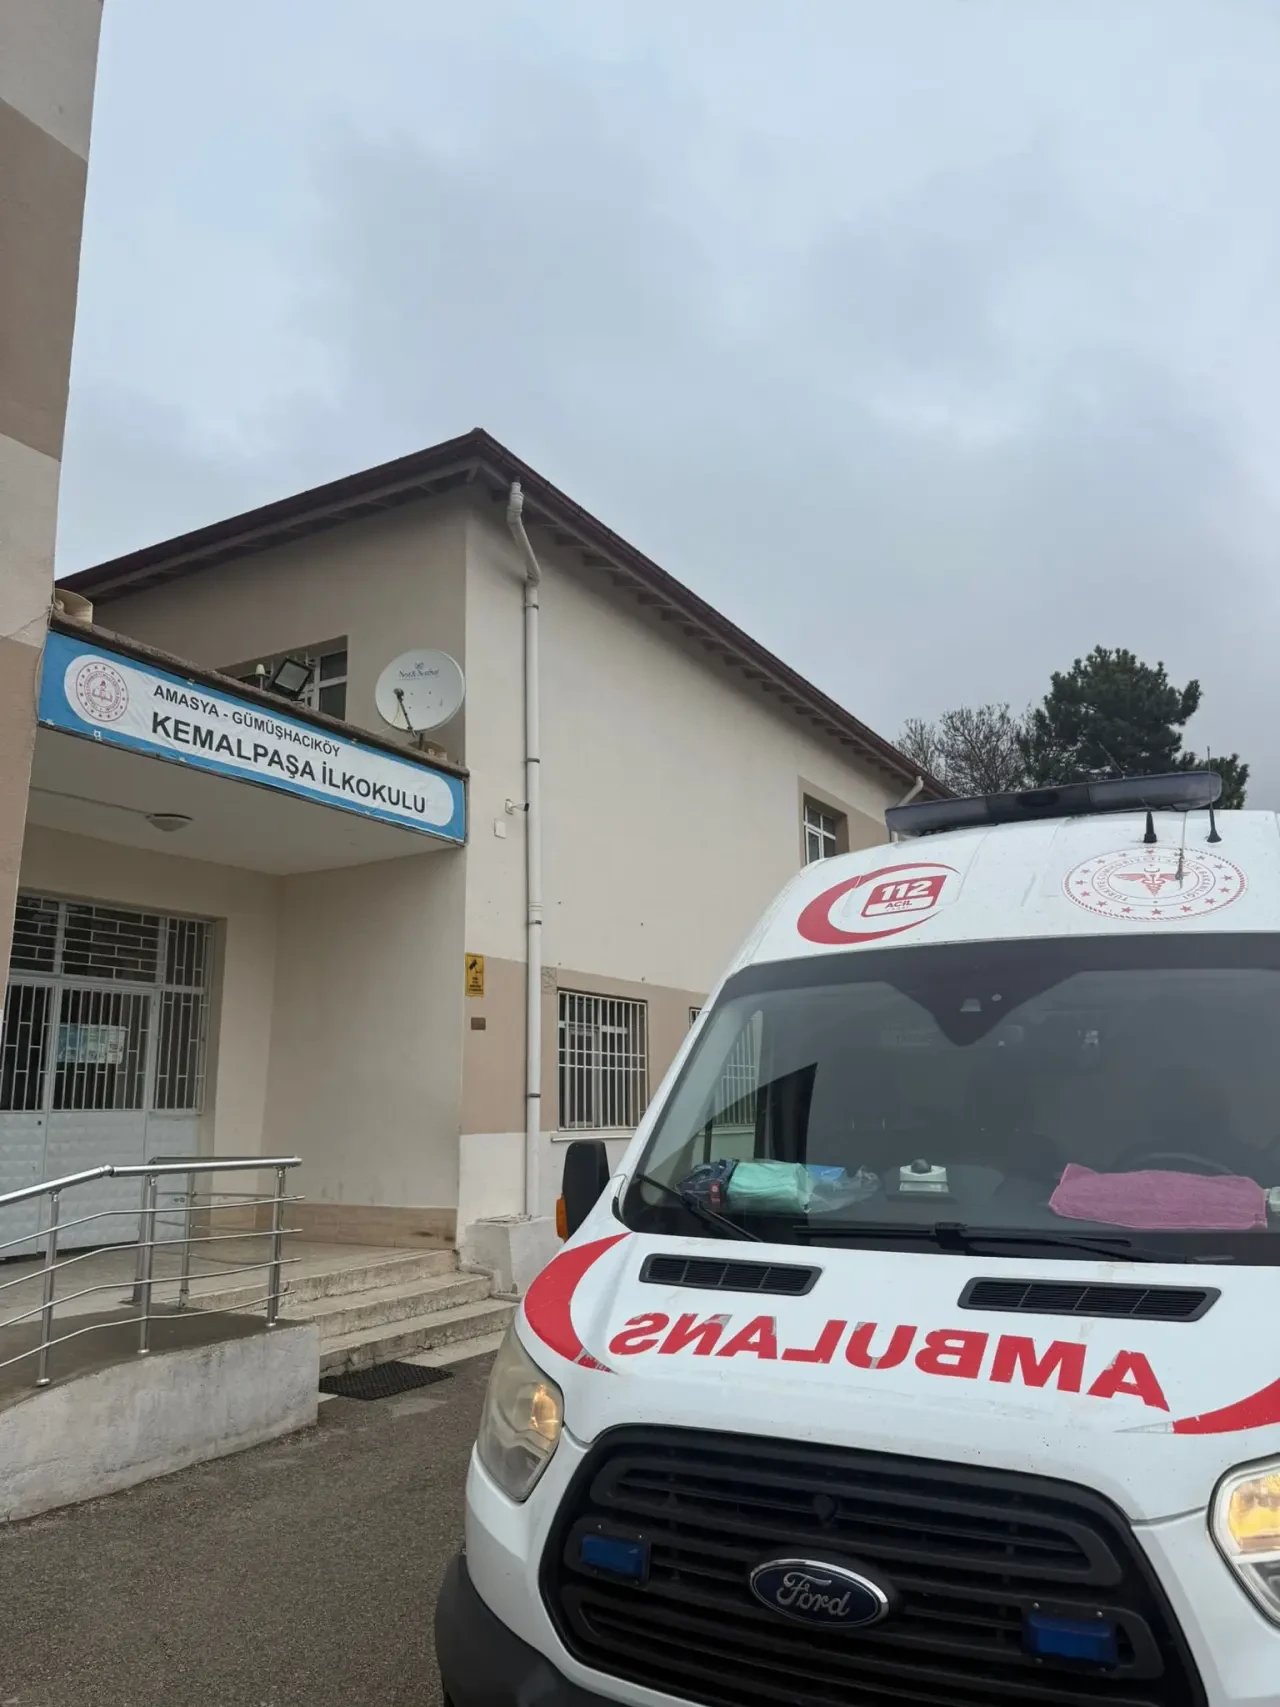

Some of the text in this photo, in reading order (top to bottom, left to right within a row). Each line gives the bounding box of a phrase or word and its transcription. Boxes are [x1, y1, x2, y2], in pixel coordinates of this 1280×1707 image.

[153, 684, 218, 717] AMASYA
[231, 710, 340, 757] GÜMÜŞHACIKÖY
[152, 712, 427, 814] KEMALPAŞA İLKOKULU
[881, 880, 932, 901] 112
[776, 1572, 851, 1616] Ford
